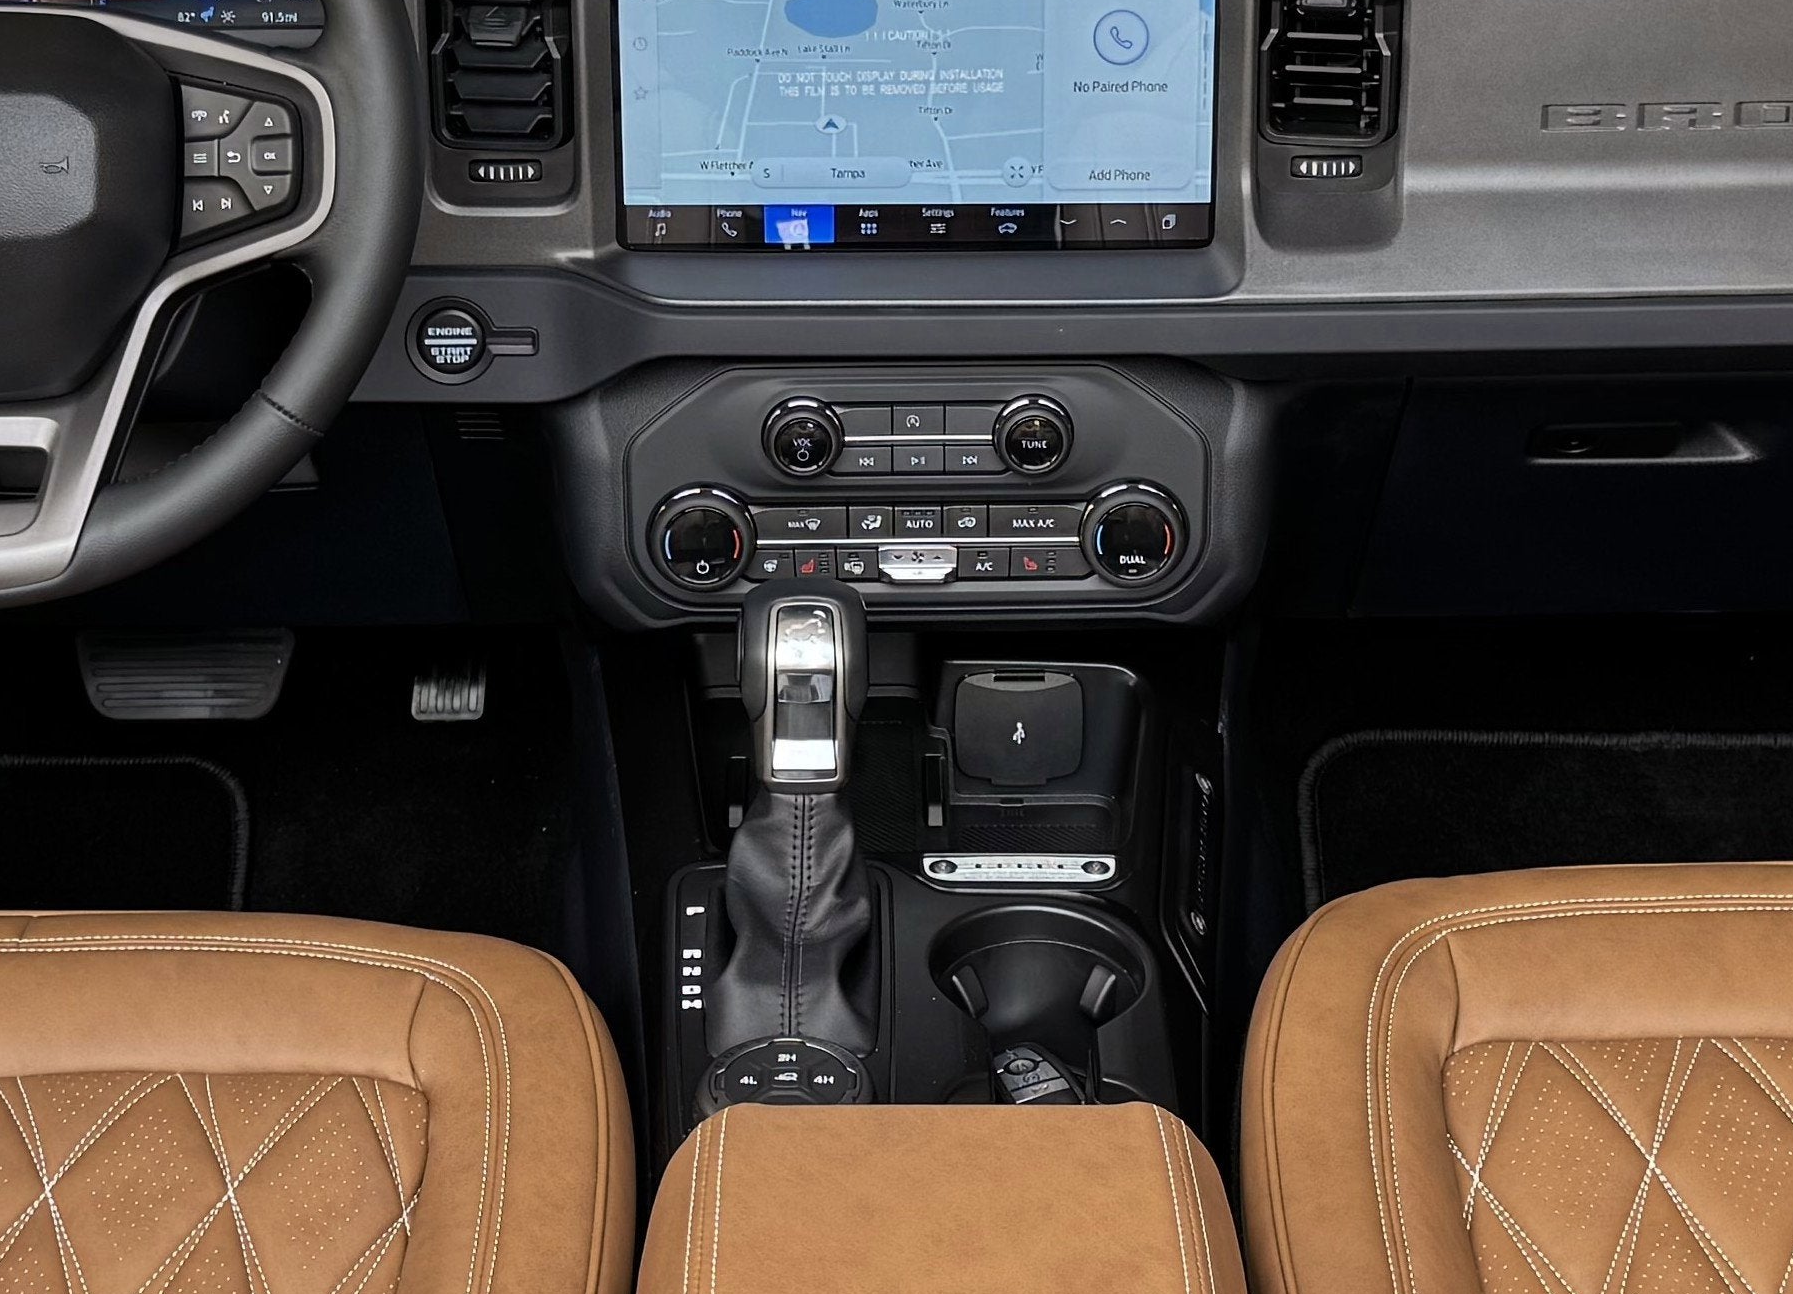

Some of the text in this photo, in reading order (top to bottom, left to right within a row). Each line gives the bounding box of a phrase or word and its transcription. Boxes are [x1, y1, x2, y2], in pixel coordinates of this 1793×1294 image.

[778, 73, 791, 83] DO
[796, 72, 815, 83] NOT
[857, 70, 894, 82] DISPLAY
[900, 70, 935, 81] DURING
[939, 68, 1004, 80] INSTALLATION
[779, 86, 799, 97] THIS
[830, 85, 839, 96] IS
[845, 85, 857, 95] TO
[863, 85, 875, 96] BE
[880, 84, 926, 95] REMOVED
[930, 82, 968, 94] BEFORE
[973, 82, 1004, 93] USAGE
[1073, 81, 1168, 93] No Paired Phone
[264, 152, 276, 160] OK
[700, 161, 745, 170] W Fletcher
[763, 168, 770, 178] S
[831, 168, 865, 179] Tampa
[1089, 170, 1151, 181] Add Phone
[648, 209, 672, 218] Audio
[717, 208, 742, 218] Phone
[859, 209, 878, 219] Apps
[922, 208, 954, 218] Settings
[991, 208, 1024, 217] Features
[428, 327, 473, 336] ENGINE
[430, 347, 473, 356] START
[436, 355, 469, 364] STOP
[1022, 440, 1047, 449] TUNE
[906, 519, 933, 529] AUTO
[1012, 518, 1055, 529] MAX A/C
[1119, 555, 1146, 565] DUAL
[975, 562, 993, 572] A/C
[739, 1075, 758, 1085] 4L
[813, 1075, 835, 1085] 4H
